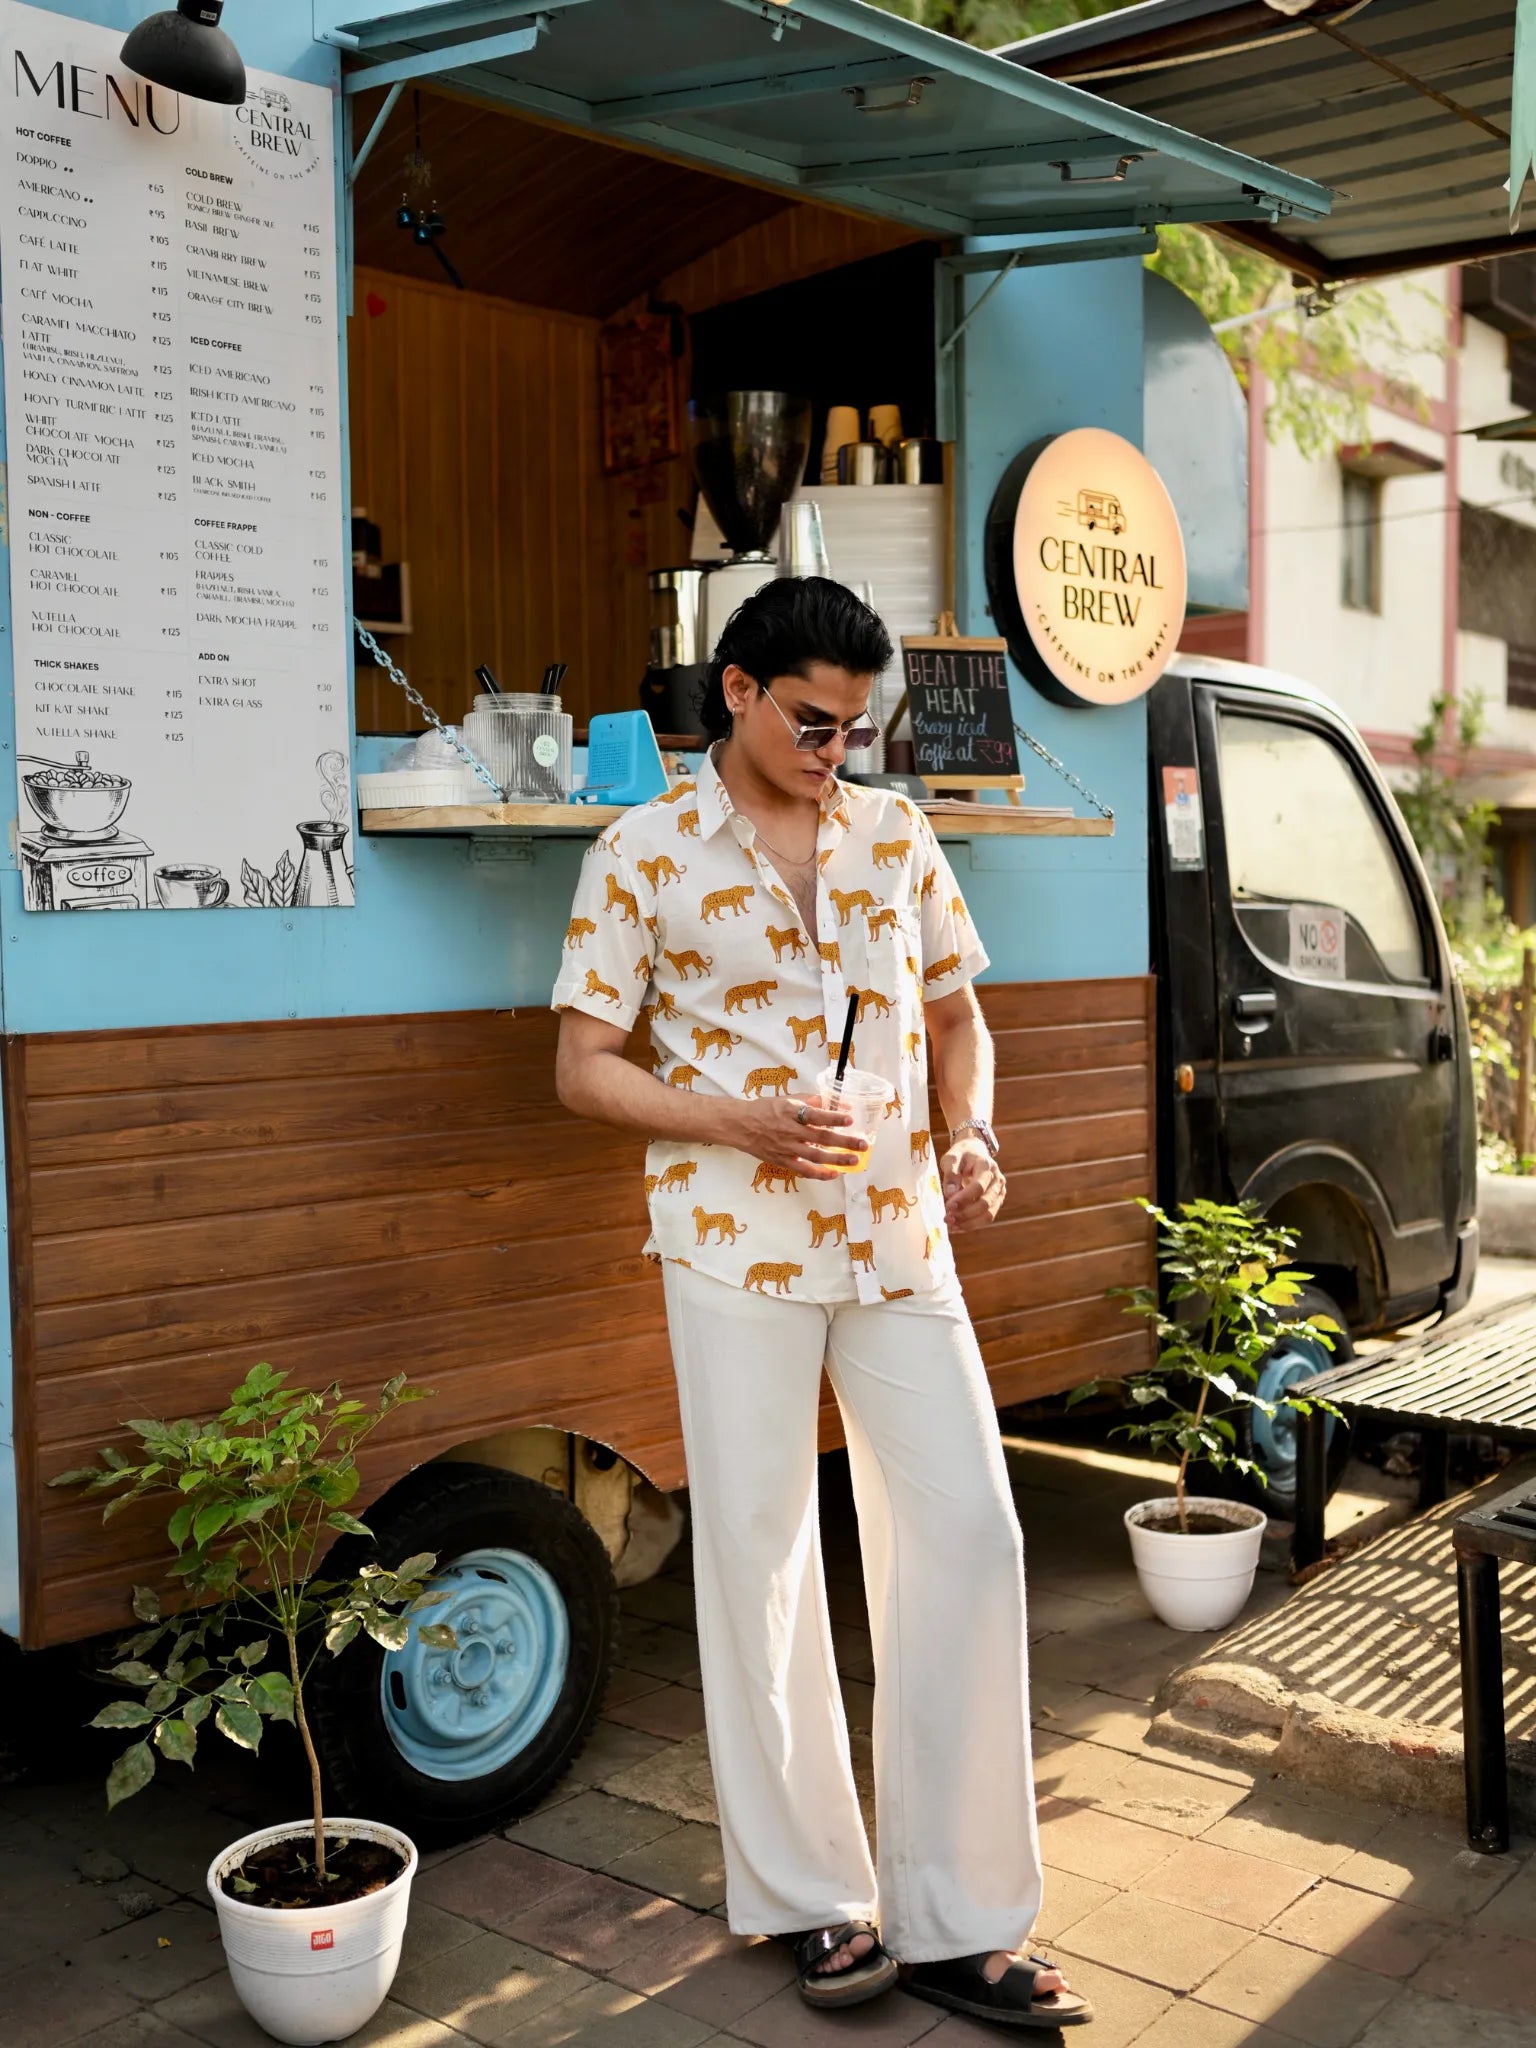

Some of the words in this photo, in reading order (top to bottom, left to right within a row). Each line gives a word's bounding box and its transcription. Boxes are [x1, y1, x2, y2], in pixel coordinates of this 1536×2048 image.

[15, 50, 179, 134] MENU
[235, 106, 318, 141] CENTRAL
[16, 126, 35, 139] HOT
[37, 132, 72, 147] COFFEE
[251, 129, 302, 157] BREW
[16, 151, 57, 170] DOPPIO
[185, 167, 208, 179] COLD
[210, 171, 233, 185] BREW
[18, 179, 81, 201] AMERICANO
[185, 191, 213, 205] COLD
[216, 195, 243, 212] BREW
[18, 205, 87, 229] CAPPUCCINO
[212, 208, 231, 219] BREW
[184, 219, 207, 232] BASIL
[213, 224, 240, 239] BREW
[19, 233, 46, 248] CAFÉ
[50, 240, 80, 255] LATTE
[185, 244, 238, 263] CRANBERRY
[240, 255, 267, 269] BREW
[19, 259, 43, 272] FLAT
[47, 264, 79, 279] WHITE
[186, 268, 240, 288] VIETNAMESE
[243, 279, 270, 293] BREW
[52, 292, 93, 309] MOCHA
[187, 291, 224, 305] ORANGE
[226, 298, 245, 310] CITY
[248, 301, 274, 315] BREW
[21, 312, 70, 330] CARAMEL
[76, 321, 136, 342] MACCHIATO
[22, 329, 50, 343] LATTE
[190, 335, 210, 346] ICED
[211, 339, 242, 352] COFFEE
[189, 363, 212, 376] ICED
[215, 368, 271, 385] AMERICANO
[23, 369, 57, 383] HONEY
[61, 376, 115, 393] CINNAMON
[117, 384, 145, 398] LATTE
[24, 392, 60, 406] HONEY
[65, 398, 116, 415] TURMERIC
[119, 406, 147, 420] LATTE
[190, 386, 214, 399] IRISH
[216, 389, 239, 402] ICED
[241, 395, 296, 413] AMERICANO
[25, 412, 57, 426] WHITE
[190, 410, 213, 423] ICED
[215, 414, 241, 427] LATTE
[25, 425, 90, 443] CHOCOLATE
[94, 434, 135, 449] MOCHA
[26, 443, 54, 456] DARK
[58, 447, 121, 465] CHOCOLATE
[26, 453, 69, 467] MOCHA
[192, 452, 214, 464] ICED
[217, 455, 255, 469] MOCHA
[27, 474, 70, 489] SPANISH
[72, 480, 102, 493] LATTE
[192, 475, 224, 488] BLACK
[227, 479, 256, 491] SMITH
[28, 508, 49, 519] NON
[56, 511, 91, 523] COFFEE
[194, 518, 225, 529] COFFEE
[227, 521, 258, 533] FRAPPE
[29, 531, 72, 545] CLASSIC
[194, 539, 234, 552] CLASSIC
[236, 543, 263, 555] COLD
[29, 543, 51, 554] HOT
[55, 546, 120, 561] CHOCOLATE
[194, 550, 231, 563] COFFEE
[1039, 536, 1163, 589] CENTRAL
[30, 568, 79, 582] CARAMEL
[195, 570, 234, 582] FRAPPES
[30, 580, 51, 591] HOT
[56, 582, 120, 597] CHOCOLATE
[1063, 585, 1142, 628] BREW
[31, 611, 76, 623] NUTELLA
[196, 612, 222, 624] DARK
[225, 615, 263, 627] MOCHA
[265, 618, 297, 630] FRAPPE
[32, 622, 53, 633] HOT
[57, 624, 121, 638] CHOCOLATE
[198, 652, 216, 661] ADD
[217, 653, 230, 662] ON
[1038, 613, 1091, 679] CAFFEINE
[1099, 671, 1116, 683] ON
[1122, 662, 1143, 680] THE
[1147, 634, 1166, 662] WAY
[34, 659, 62, 669] THICK
[63, 661, 99, 671] SHAKES
[907, 653, 957, 686] BEAT
[963, 655, 1007, 689] THE
[34, 681, 99, 694] CHOCOLATE
[102, 685, 136, 696] SHAKE
[198, 675, 229, 686] EXTRA
[231, 677, 256, 688] SHOT
[35, 703, 50, 713] KIT
[54, 704, 73, 714] KAT
[77, 705, 110, 716] SHAKE
[199, 696, 229, 707] EXTRA
[232, 698, 263, 709] GLASS
[925, 687, 980, 715] HEAT
[36, 726, 80, 738] NUTELLA
[83, 728, 117, 740] SHAKE
[956, 711, 987, 737] iced
[956, 736, 977, 762] at
[71, 866, 128, 883] coffee
